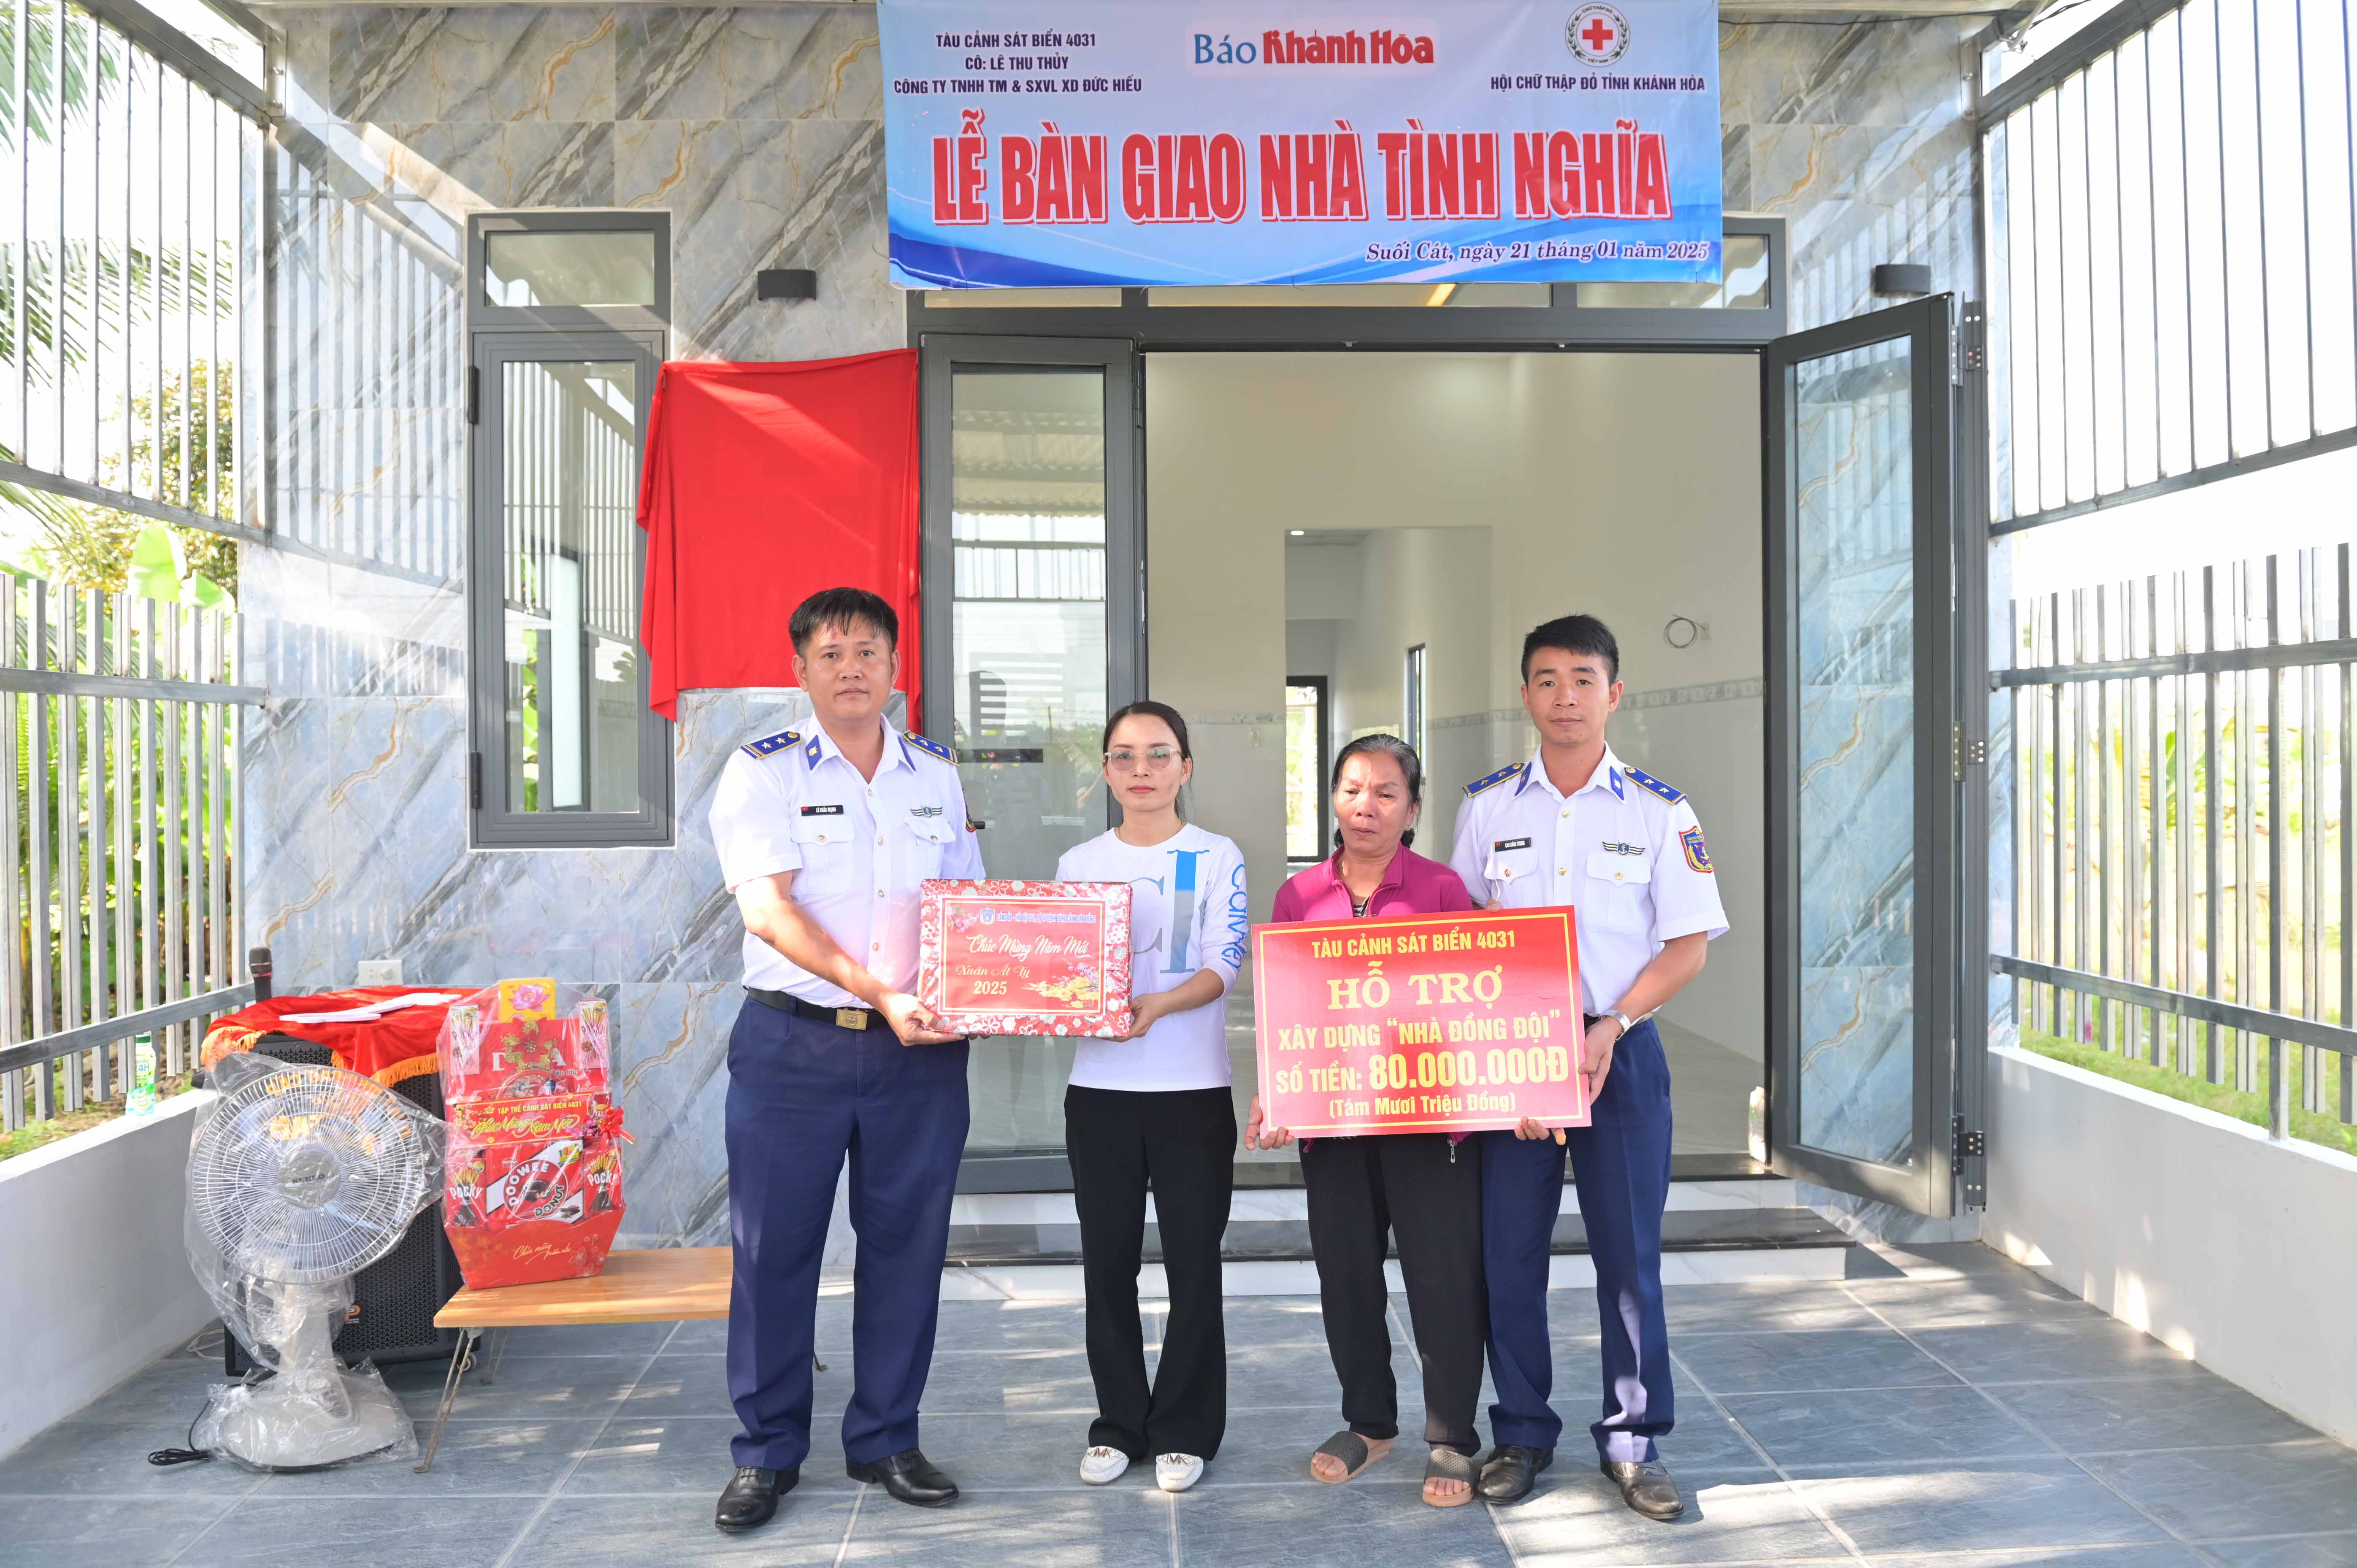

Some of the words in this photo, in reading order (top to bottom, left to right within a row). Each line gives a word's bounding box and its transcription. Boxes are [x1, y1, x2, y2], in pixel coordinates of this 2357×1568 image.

[936, 32, 960, 48] TÀU
[964, 30, 999, 48] CẢNH
[1004, 32, 1028, 47] SÁT
[1032, 28, 1062, 47] BIỂN
[1066, 33, 1096, 47] 4031
[1194, 35, 1256, 64] Báo
[965, 54, 986, 70] CÔ:
[990, 54, 1004, 70] LÊ
[1009, 57, 1033, 70] THU
[1037, 52, 1069, 70] THỦY
[894, 78, 928, 94] CÔNG
[932, 80, 946, 94] TY
[950, 80, 984, 93] TNHH
[988, 79, 1007, 93] TM
[1012, 80, 1021, 93] &
[1026, 79, 1058, 93] SXVL
[1062, 79, 1078, 92] XD
[1082, 76, 1109, 92] ĐỨC
[1113, 75, 1142, 92] HIẾU
[1491, 74, 1512, 92] HỘI
[1516, 74, 1542, 89] CHỮ
[1545, 73, 1576, 92] THẬP
[1580, 72, 1597, 90] ĐỎ
[1602, 72, 1629, 90] TỈNH
[1634, 75, 1676, 90] KHÁNH
[1680, 75, 1705, 91] HÒA
[932, 108, 988, 225] LỄ
[1000, 121, 1108, 225] BÀN
[1121, 132, 1247, 225] GIAO
[1259, 119, 1369, 222] NHÀ
[1377, 119, 1501, 221] TÌNH
[1513, 119, 1673, 221] NGHĨA
[1366, 241, 1409, 261] Suối
[1417, 243, 1453, 262] Cát,
[1459, 245, 1506, 262] ngày
[1510, 243, 1529, 258] 21
[1537, 242, 1592, 261] tháng
[1598, 241, 1617, 257] 01
[1623, 243, 1662, 258] năm
[1667, 242, 1709, 259] 2025
[966, 934, 996, 953] Chúc
[999, 934, 1033, 962] Mừng
[1035, 935, 1061, 955] Năm
[1064, 935, 1093, 959] Mới
[1312, 940, 1342, 958] TÀU
[1348, 933, 1392, 957] CẢNH
[1396, 933, 1427, 954] SÁT
[1433, 926, 1472, 952] BIỂN
[1477, 930, 1515, 949] 4031
[955, 965, 989, 976] Xuân
[973, 981, 1007, 995] 2025
[1327, 960, 1390, 1010] HỖ
[1408, 965, 1503, 1009] TRỢ
[1278, 1024, 1317, 1050] XÂY
[1324, 1024, 1380, 1053] DỰNG
[1448, 1012, 1507, 1042] ĐỒNG
[1276, 1061, 1303, 1094] SỐ
[1309, 1059, 1362, 1092] TIỀN:
[1368, 1046, 1569, 1090] 80.000.000Đ
[498, 1107, 509, 1115] TẬP
[510, 1104, 521, 1113] THỂ
[522, 1103, 539, 1112] CẢNH
[541, 1101, 551, 1111] SÁT
[553, 1100, 567, 1109] BIỂN
[1329, 1098, 1369, 1119] (Tám
[1375, 1096, 1415, 1116] Mươi
[1420, 1093, 1461, 1117] Triệu
[1467, 1090, 1516, 1113] Đồng)
[449, 1184, 483, 1200] POCKY
[506, 1161, 549, 1207] DOOWEE
[534, 1185, 564, 1217] DONUT
